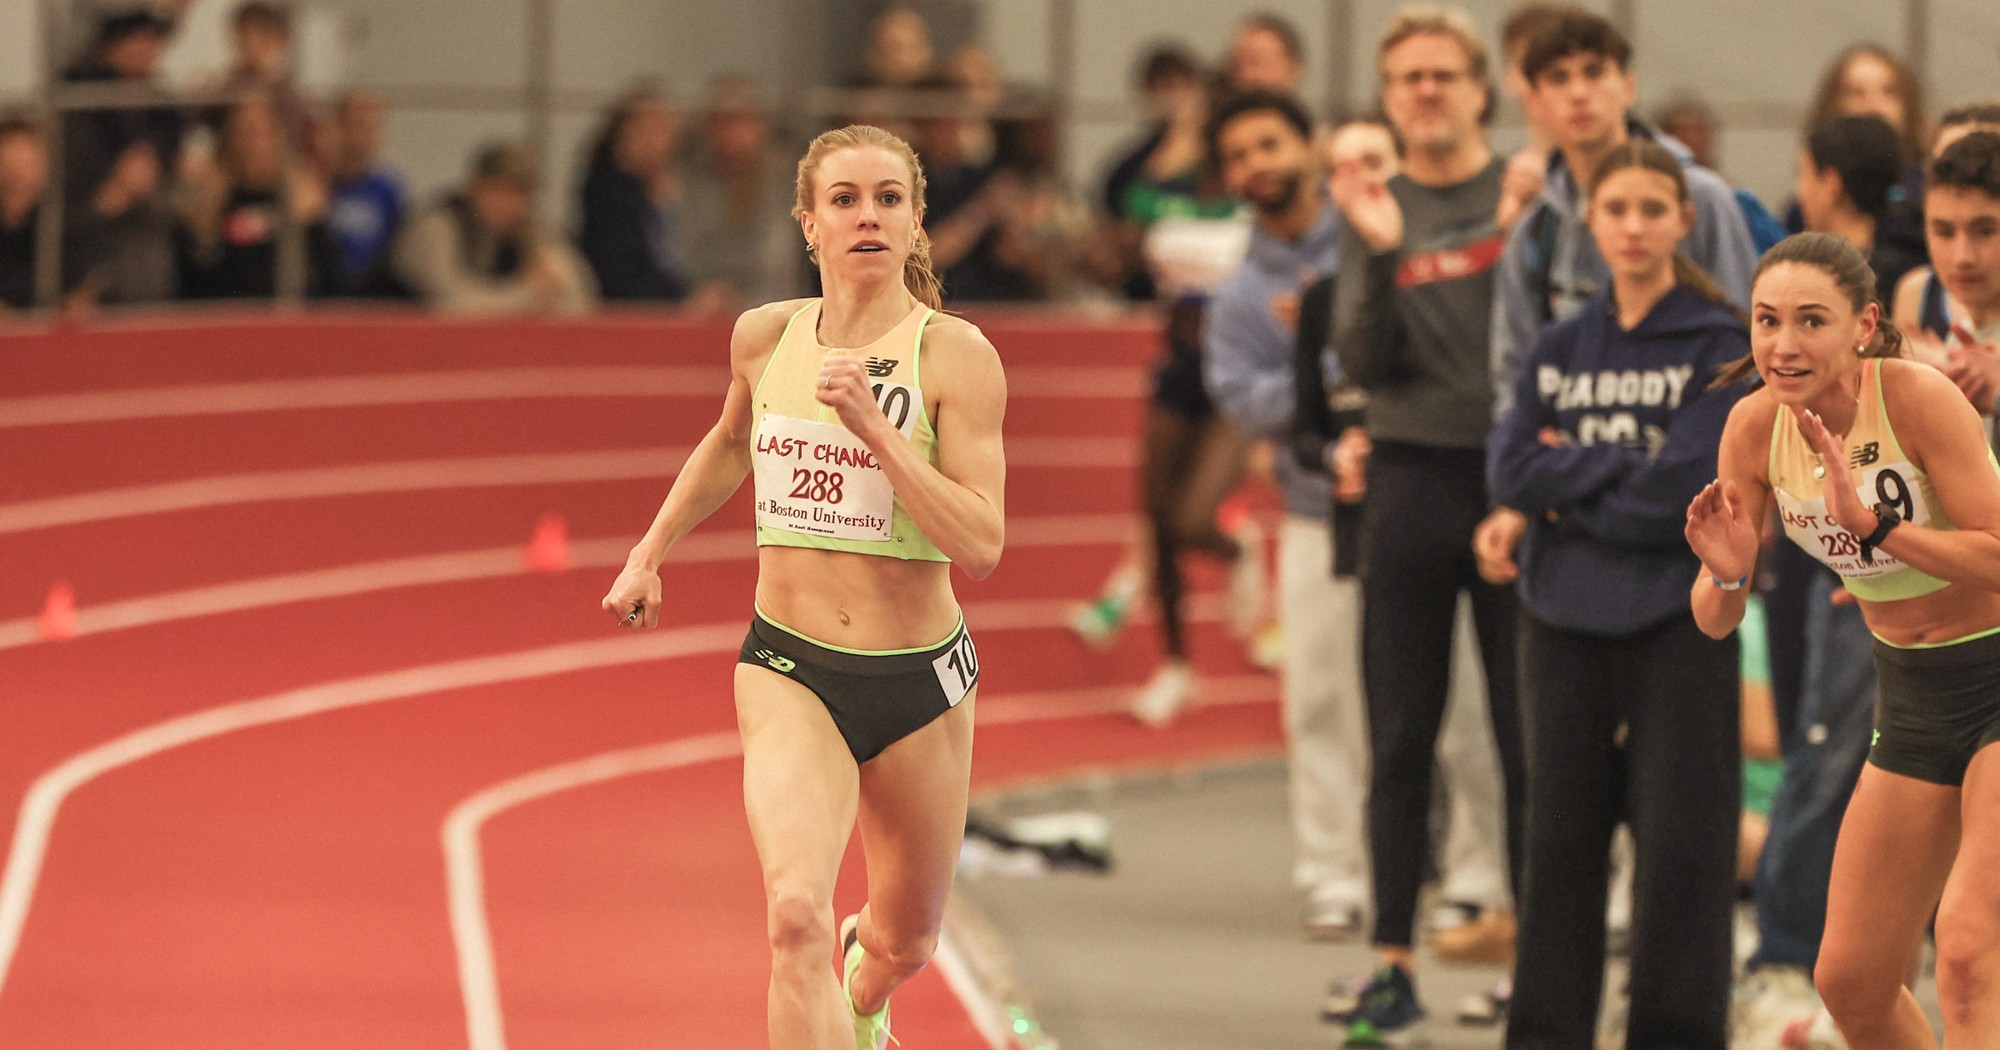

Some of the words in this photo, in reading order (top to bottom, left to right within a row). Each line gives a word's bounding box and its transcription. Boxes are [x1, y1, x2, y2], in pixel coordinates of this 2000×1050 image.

[757, 434, 808, 460] LAST
[814, 444, 881, 470] CHANC
[788, 467, 844, 505] 288
[1876, 468, 1914, 522] 9
[758, 501, 767, 512] at
[769, 500, 808, 520] Boston
[813, 507, 886, 531] University
[1782, 506, 1820, 530] LAST
[1829, 561, 1855, 571] ston
[1855, 558, 1897, 570] Univer
[947, 633, 977, 690] 10
